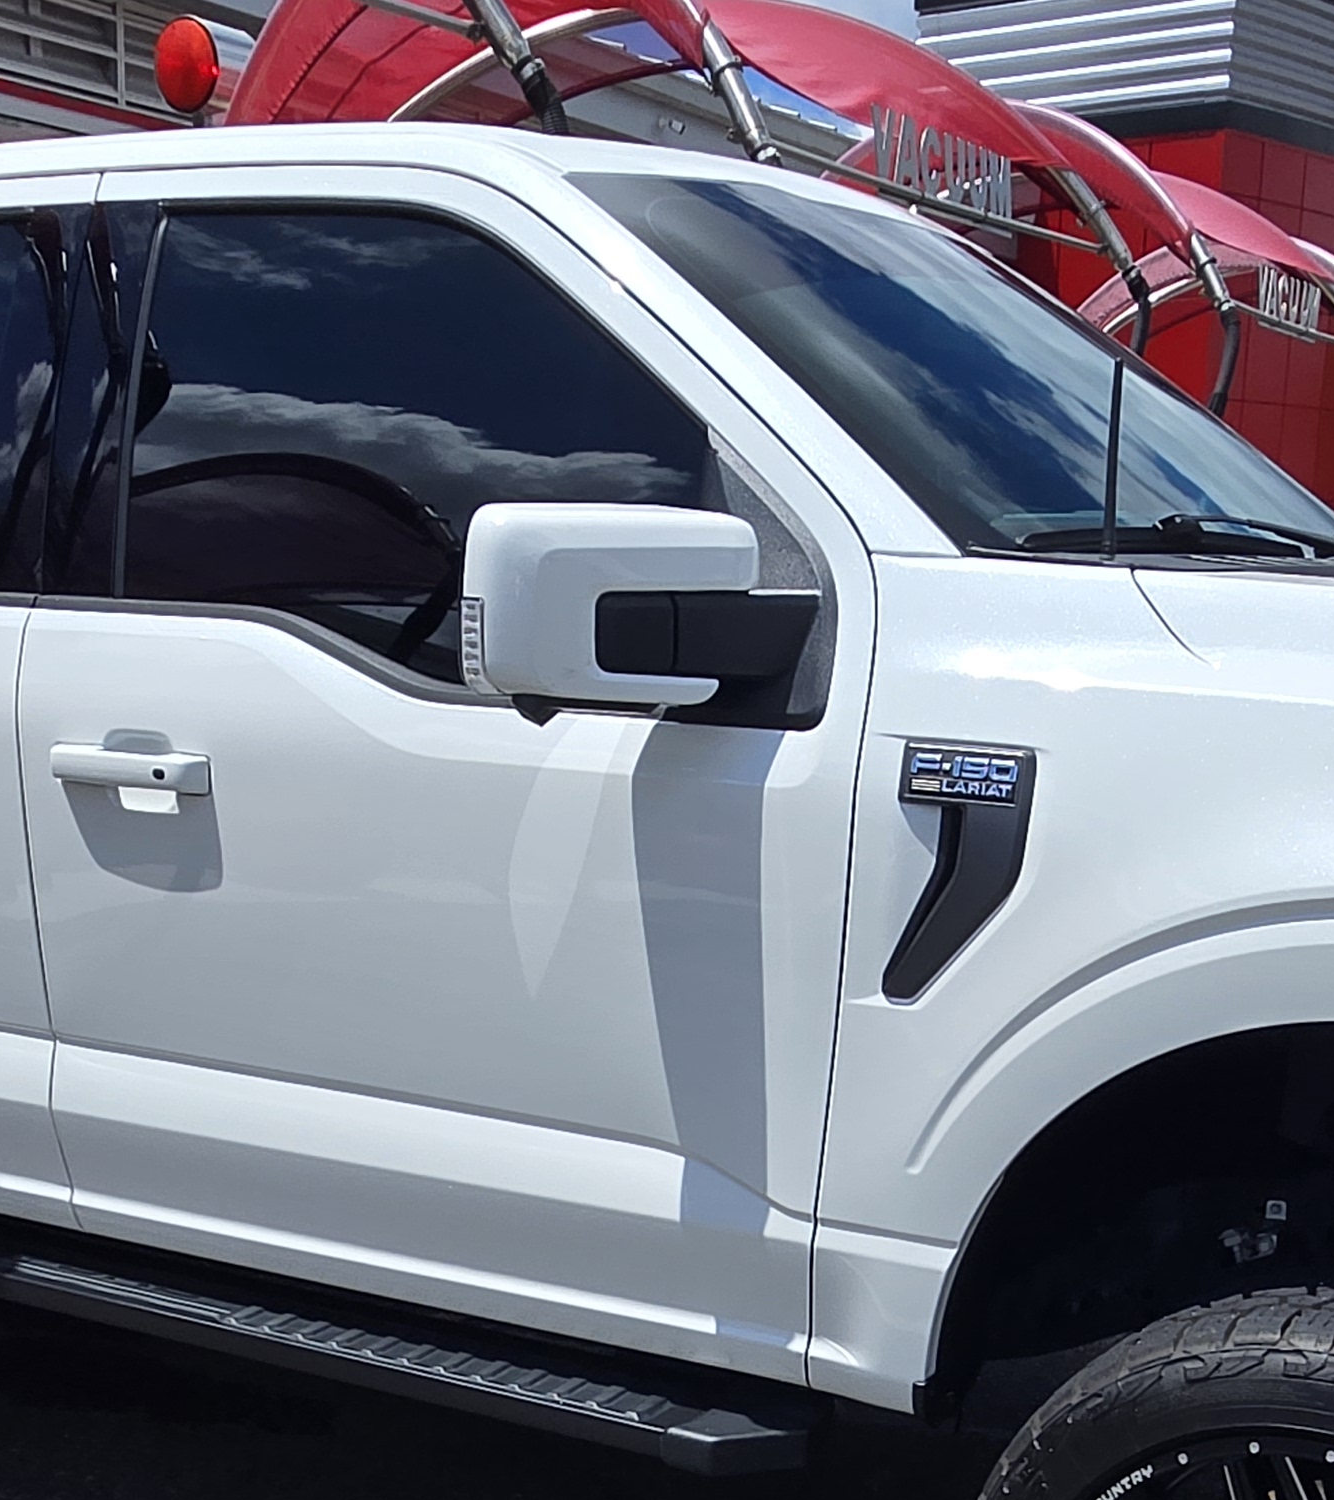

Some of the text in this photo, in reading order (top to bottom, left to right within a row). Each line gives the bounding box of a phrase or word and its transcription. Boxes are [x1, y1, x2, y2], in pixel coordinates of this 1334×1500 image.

[871, 102, 1012, 219] VACUUM
[1258, 261, 1322, 332] VACUUM
[910, 752, 1018, 782] F-150
[942, 780, 1013, 797] LARIAT
